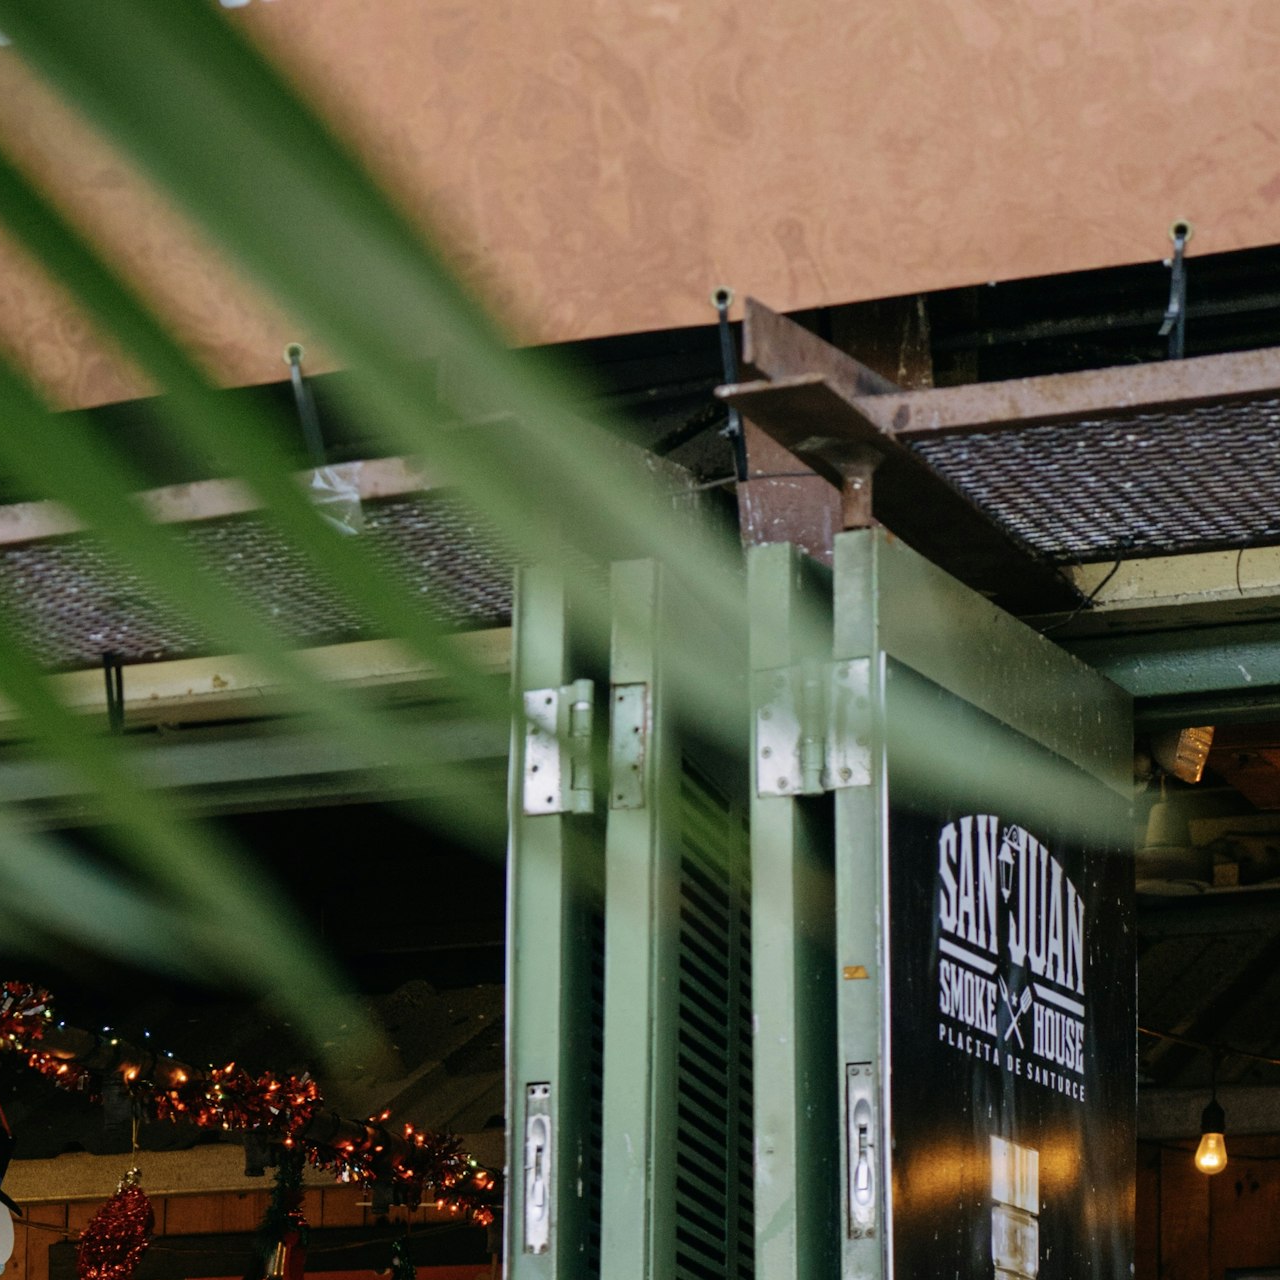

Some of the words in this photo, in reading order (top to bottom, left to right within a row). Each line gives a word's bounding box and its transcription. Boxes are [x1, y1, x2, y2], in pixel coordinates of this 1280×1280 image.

[940, 815, 997, 955] SAN
[1008, 826, 1085, 996] JUAN
[940, 959, 997, 1037] SMOKE
[1033, 1002, 1085, 1075] HOUSE
[940, 1024, 1001, 1065] PLACITA
[1007, 1054, 1022, 1075] DE
[1027, 1062, 1085, 1102] SANTURCE
